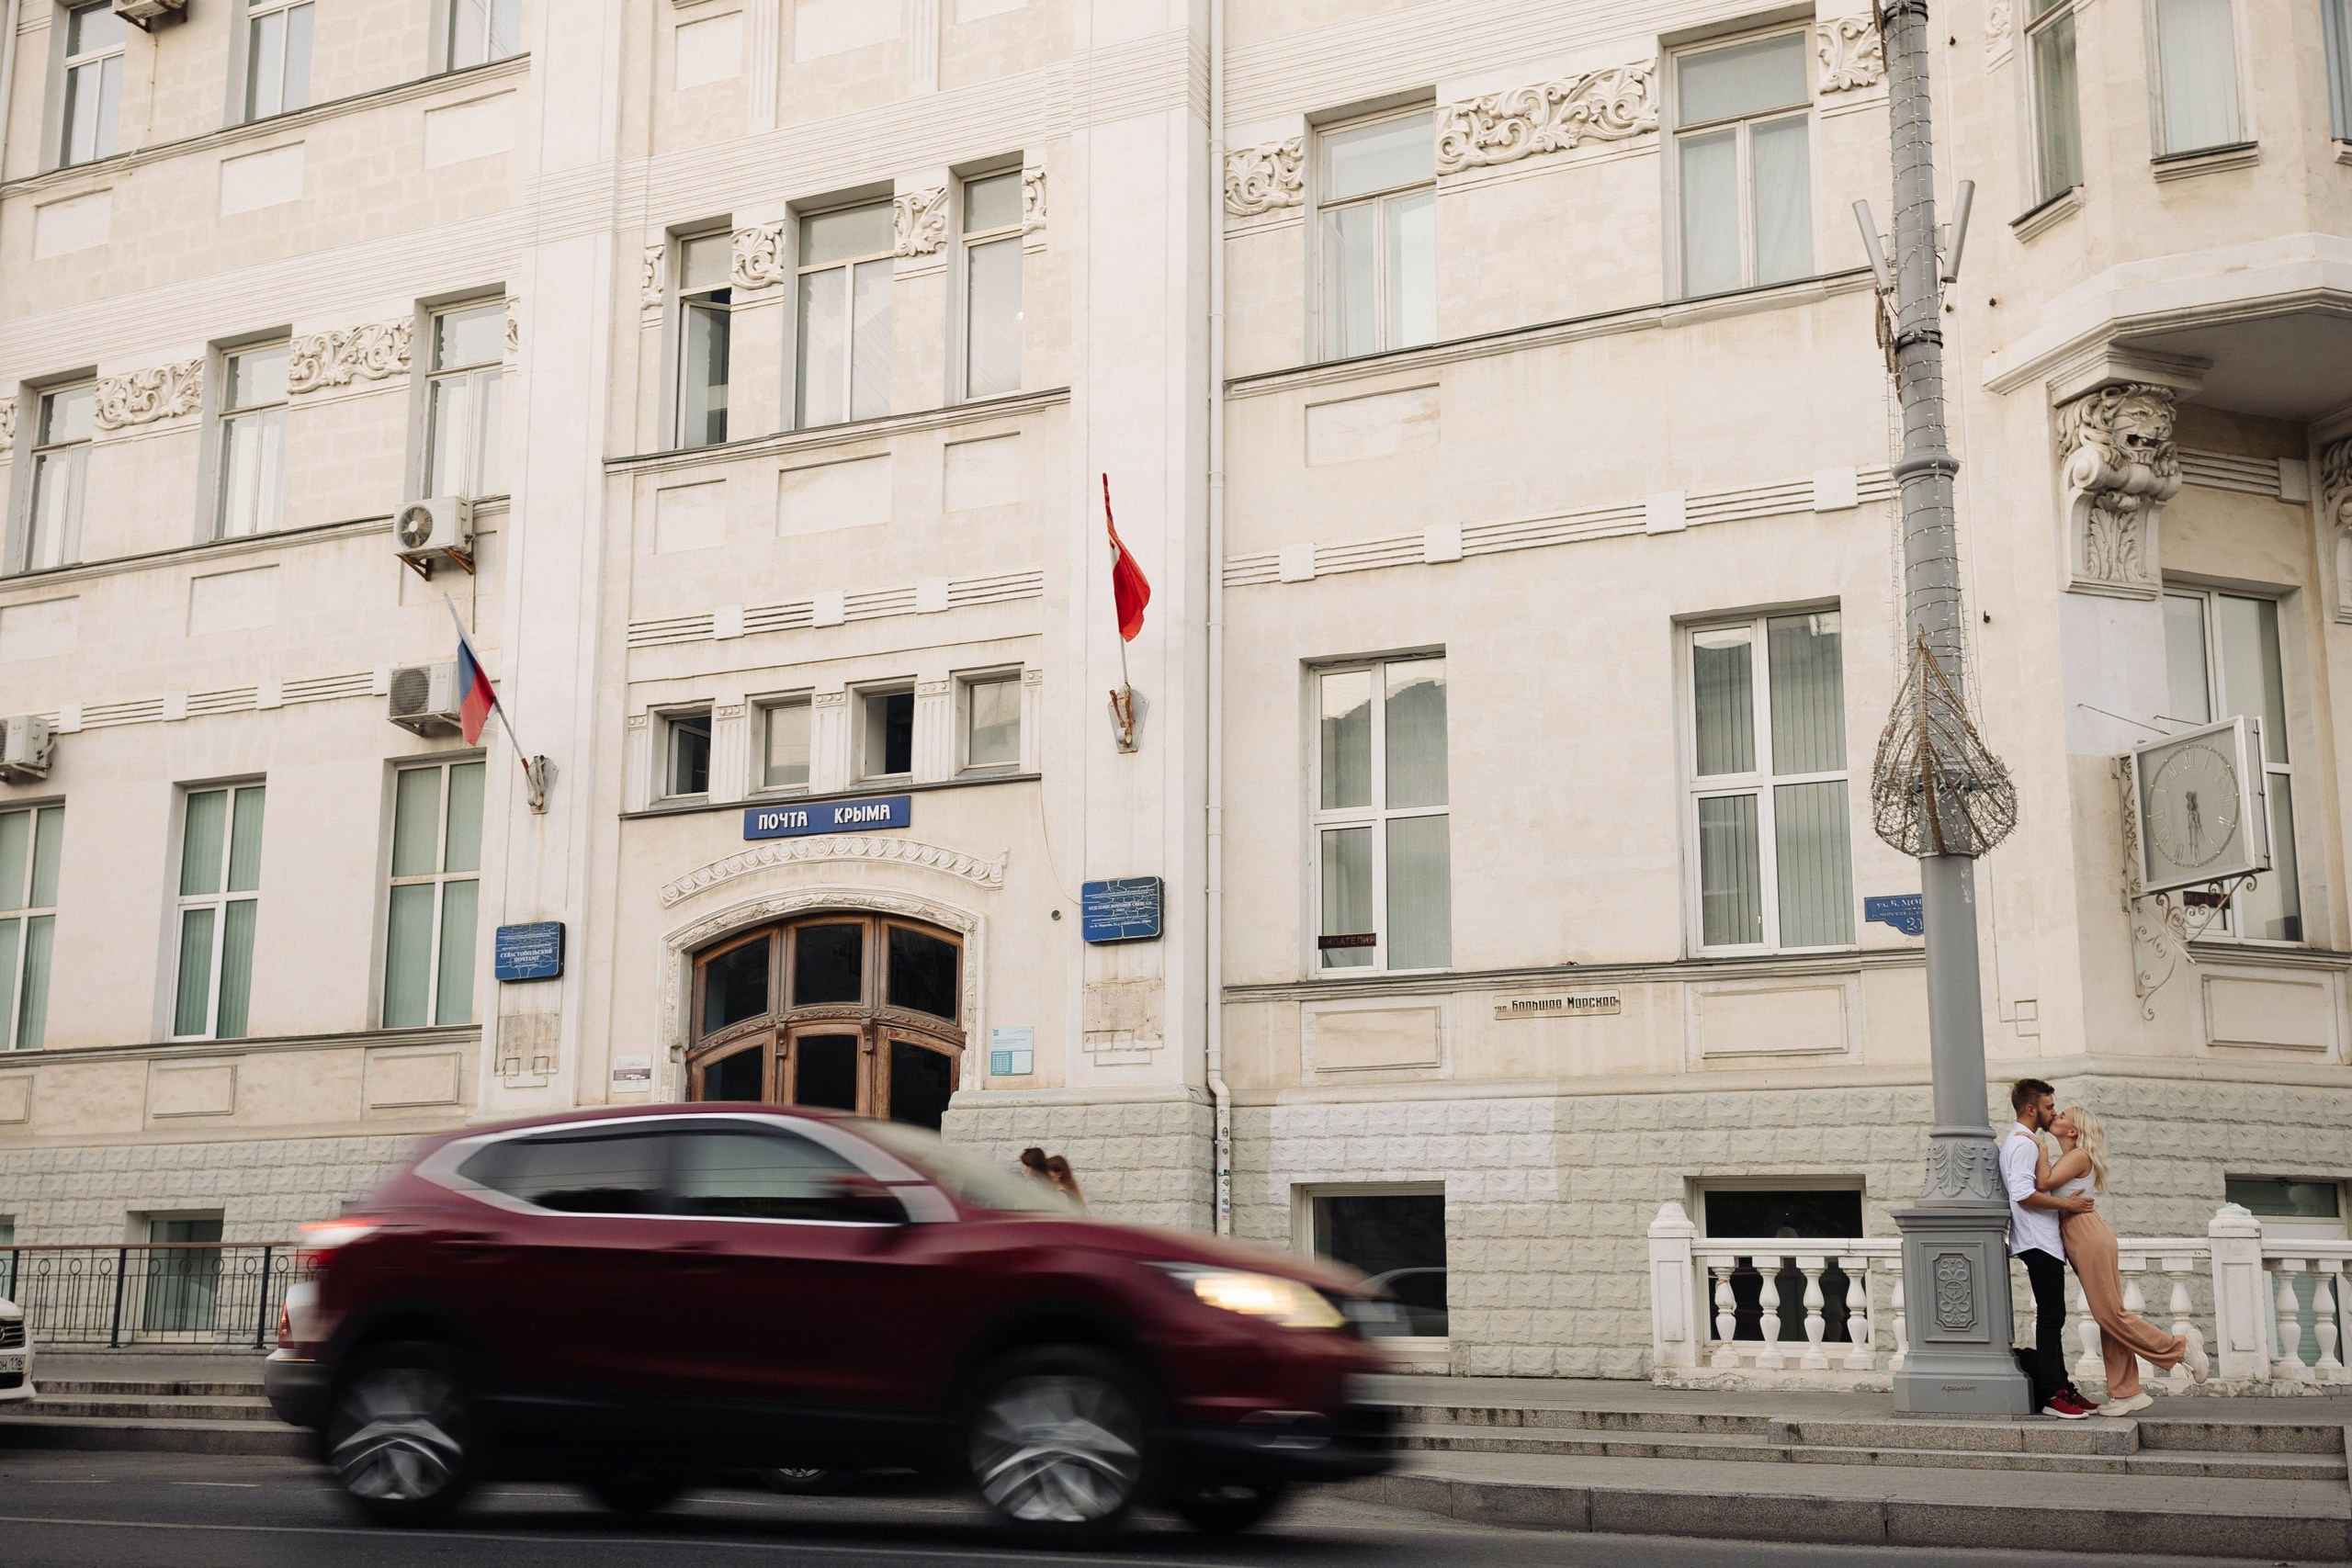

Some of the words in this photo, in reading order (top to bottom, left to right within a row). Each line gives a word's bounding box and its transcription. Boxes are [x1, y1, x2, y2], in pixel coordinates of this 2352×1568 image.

[758, 810, 808, 830] ПОЧТА
[834, 804, 891, 824] КРЫМА
[500, 948, 552, 958] СЕВАСТОПОЛЬСКИЙ
[1567, 996, 1616, 1010] Морская
